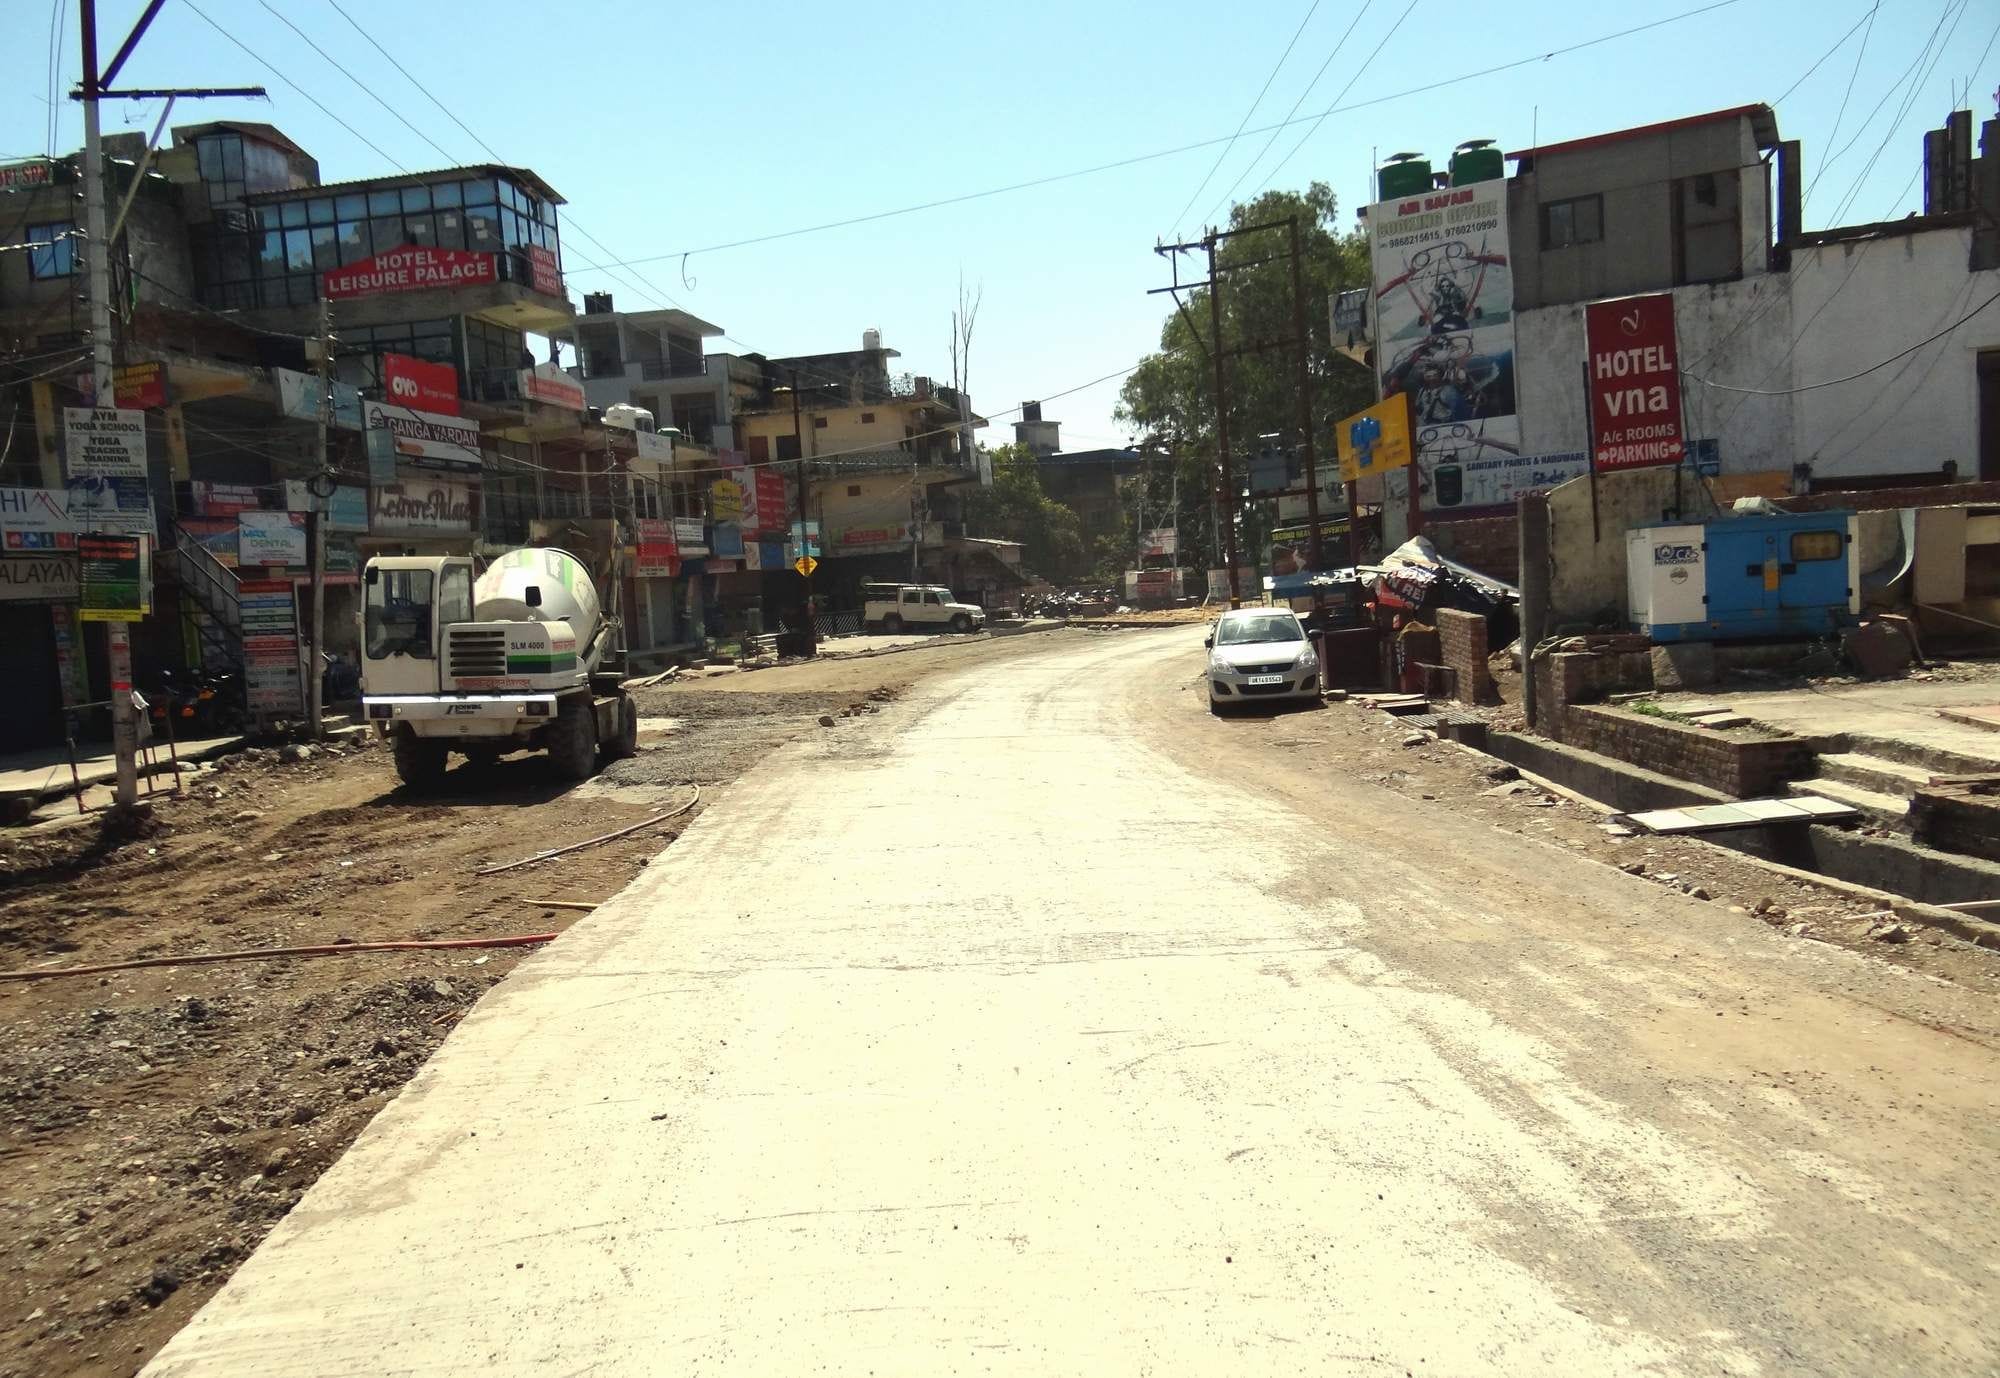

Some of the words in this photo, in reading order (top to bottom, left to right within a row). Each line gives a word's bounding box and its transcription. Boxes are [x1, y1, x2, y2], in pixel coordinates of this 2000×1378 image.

[375, 251, 438, 271] HOTEL
[329, 269, 409, 292] LEISURE
[415, 262, 488, 282] PALACE
[1596, 345, 1672, 379] HOTEL
[1604, 385, 1669, 417] vna
[91, 411, 117, 421] AYM
[69, 422, 97, 431] YOGA
[100, 423, 142, 432] SCHOOL
[388, 418, 431, 440] GANGA
[433, 426, 478, 447] VARDAN
[1603, 431, 1623, 445] A/c
[1627, 424, 1675, 441] ROOMS
[1542, 452, 1585, 464] HARDWARE
[1609, 441, 1670, 463] PARKING
[510, 642, 527, 650] SLM
[527, 641, 545, 649] 4000
